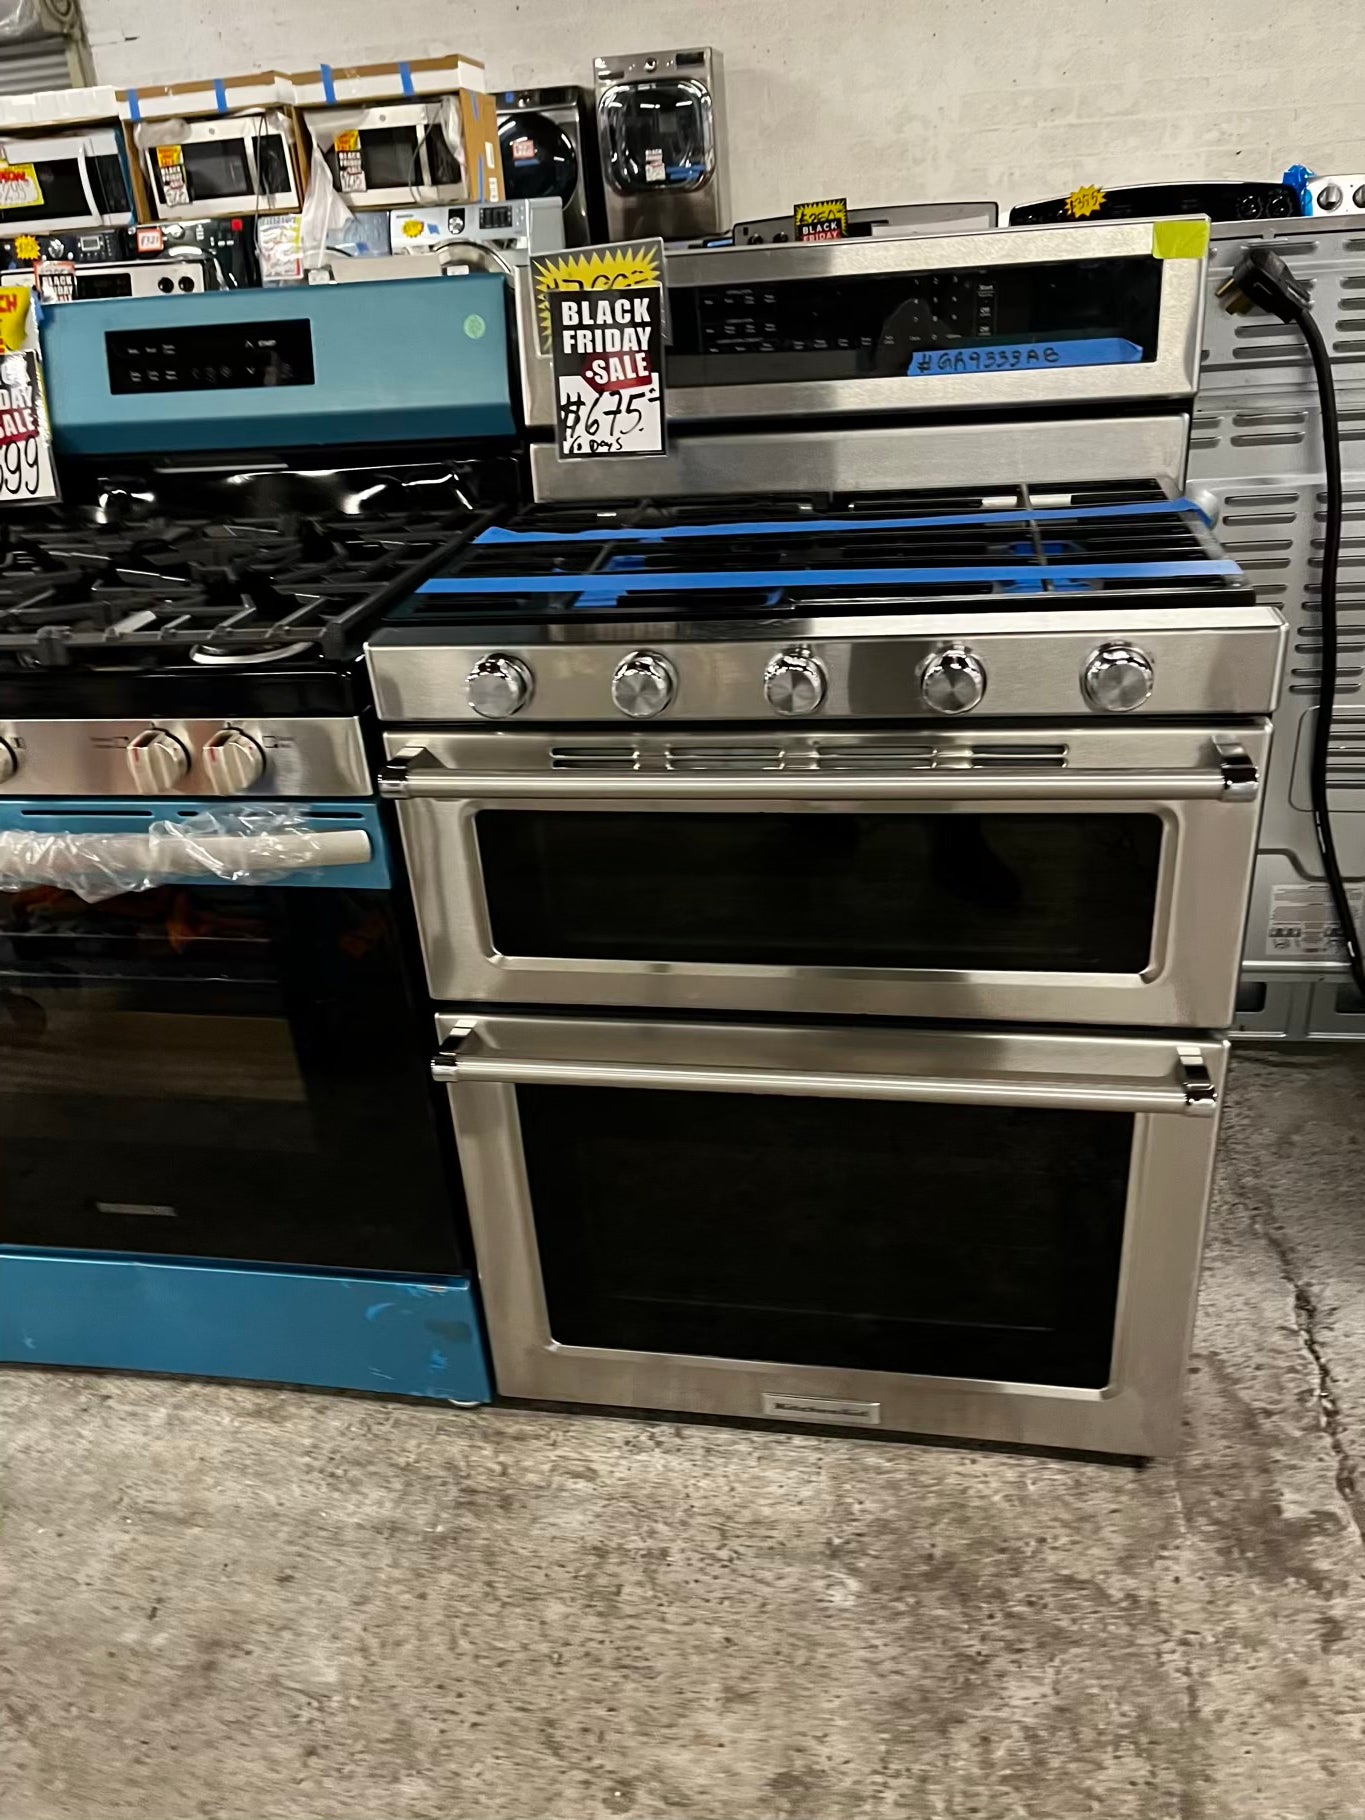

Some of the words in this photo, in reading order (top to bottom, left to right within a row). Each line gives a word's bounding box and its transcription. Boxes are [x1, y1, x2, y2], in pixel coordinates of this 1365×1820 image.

[802, 221, 838, 235] BLACK
[803, 231, 839, 242] FRIDAY
[561, 297, 652, 326] BLACK
[562, 326, 652, 354] FRIDAY
[592, 352, 650, 385] SALE
[0, 434, 40, 495] 99
